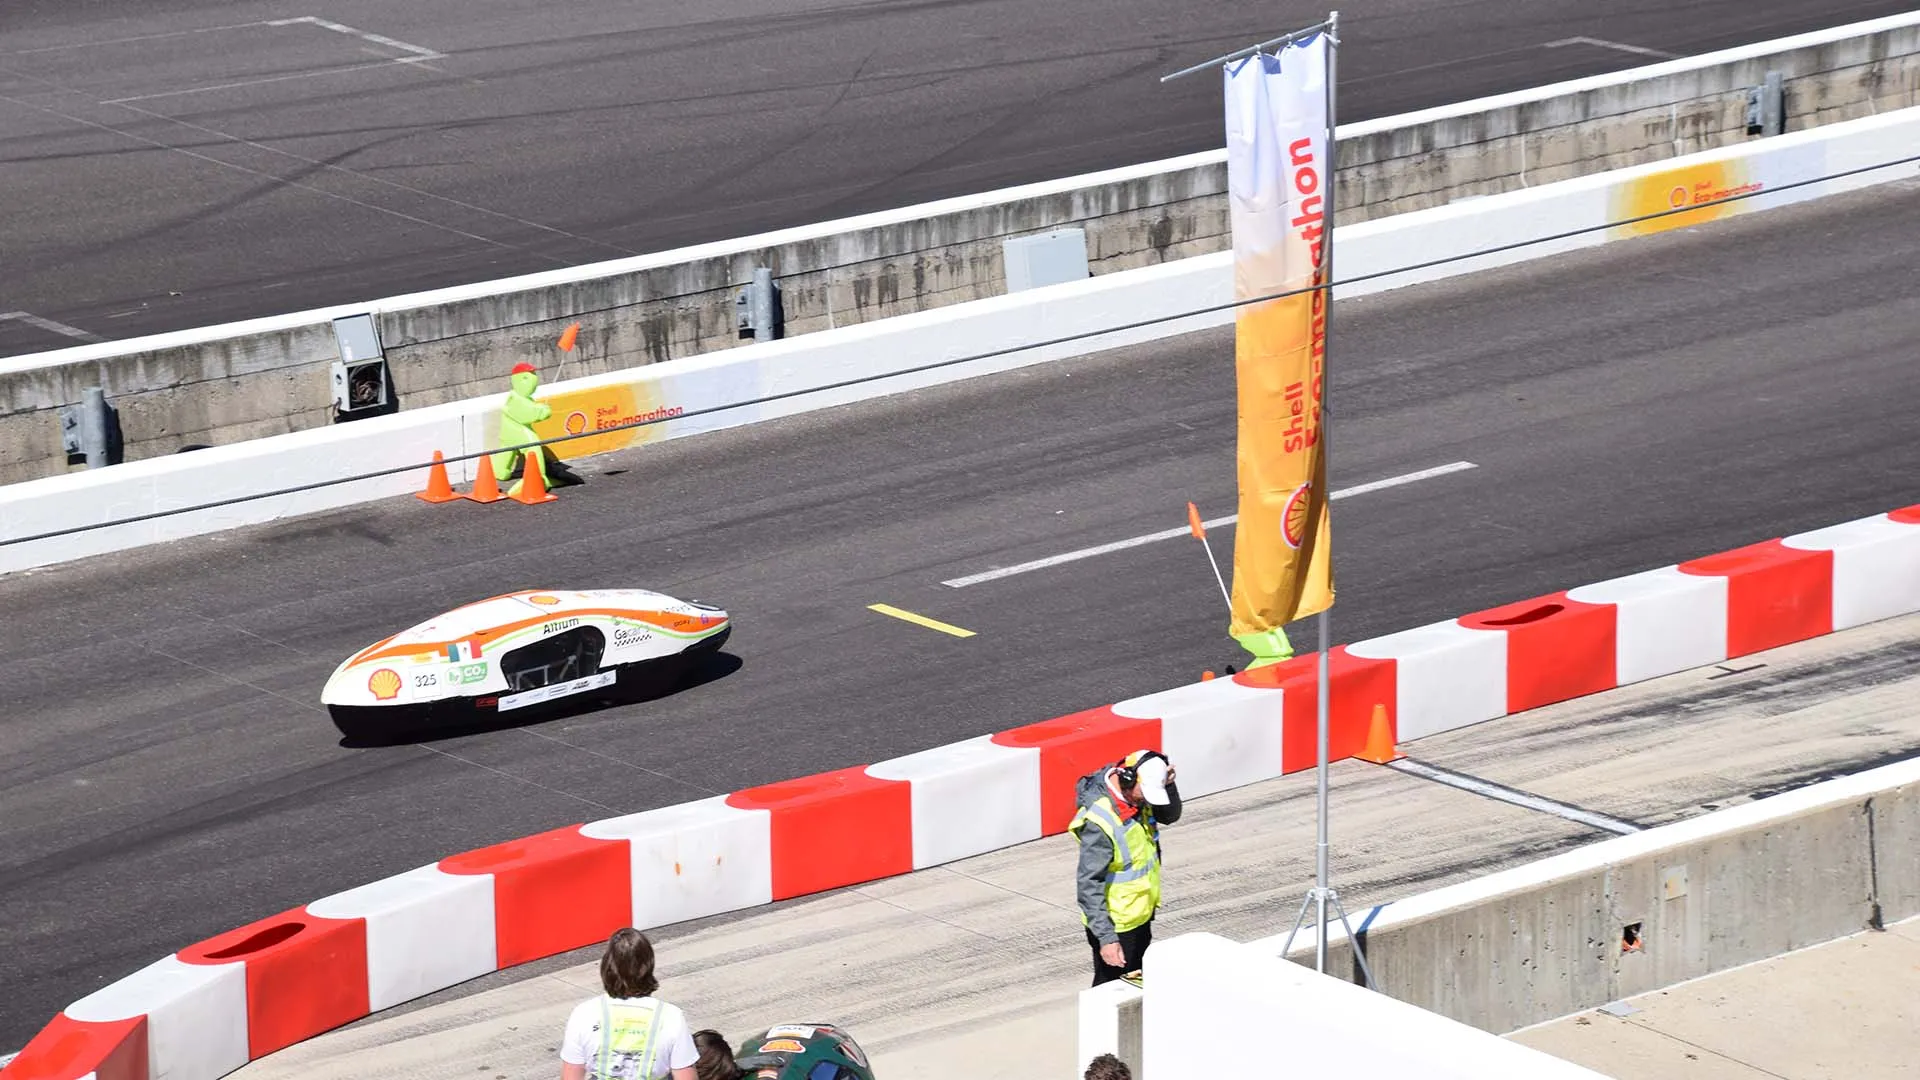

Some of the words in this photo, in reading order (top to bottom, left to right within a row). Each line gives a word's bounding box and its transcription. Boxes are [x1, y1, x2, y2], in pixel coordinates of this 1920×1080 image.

[596, 404, 684, 430] Eco-marathon
[597, 405, 618, 418] Shell
[1283, 380, 1304, 454] Shell
[544, 618, 580, 635] Altium
[415, 673, 437, 687] 325
